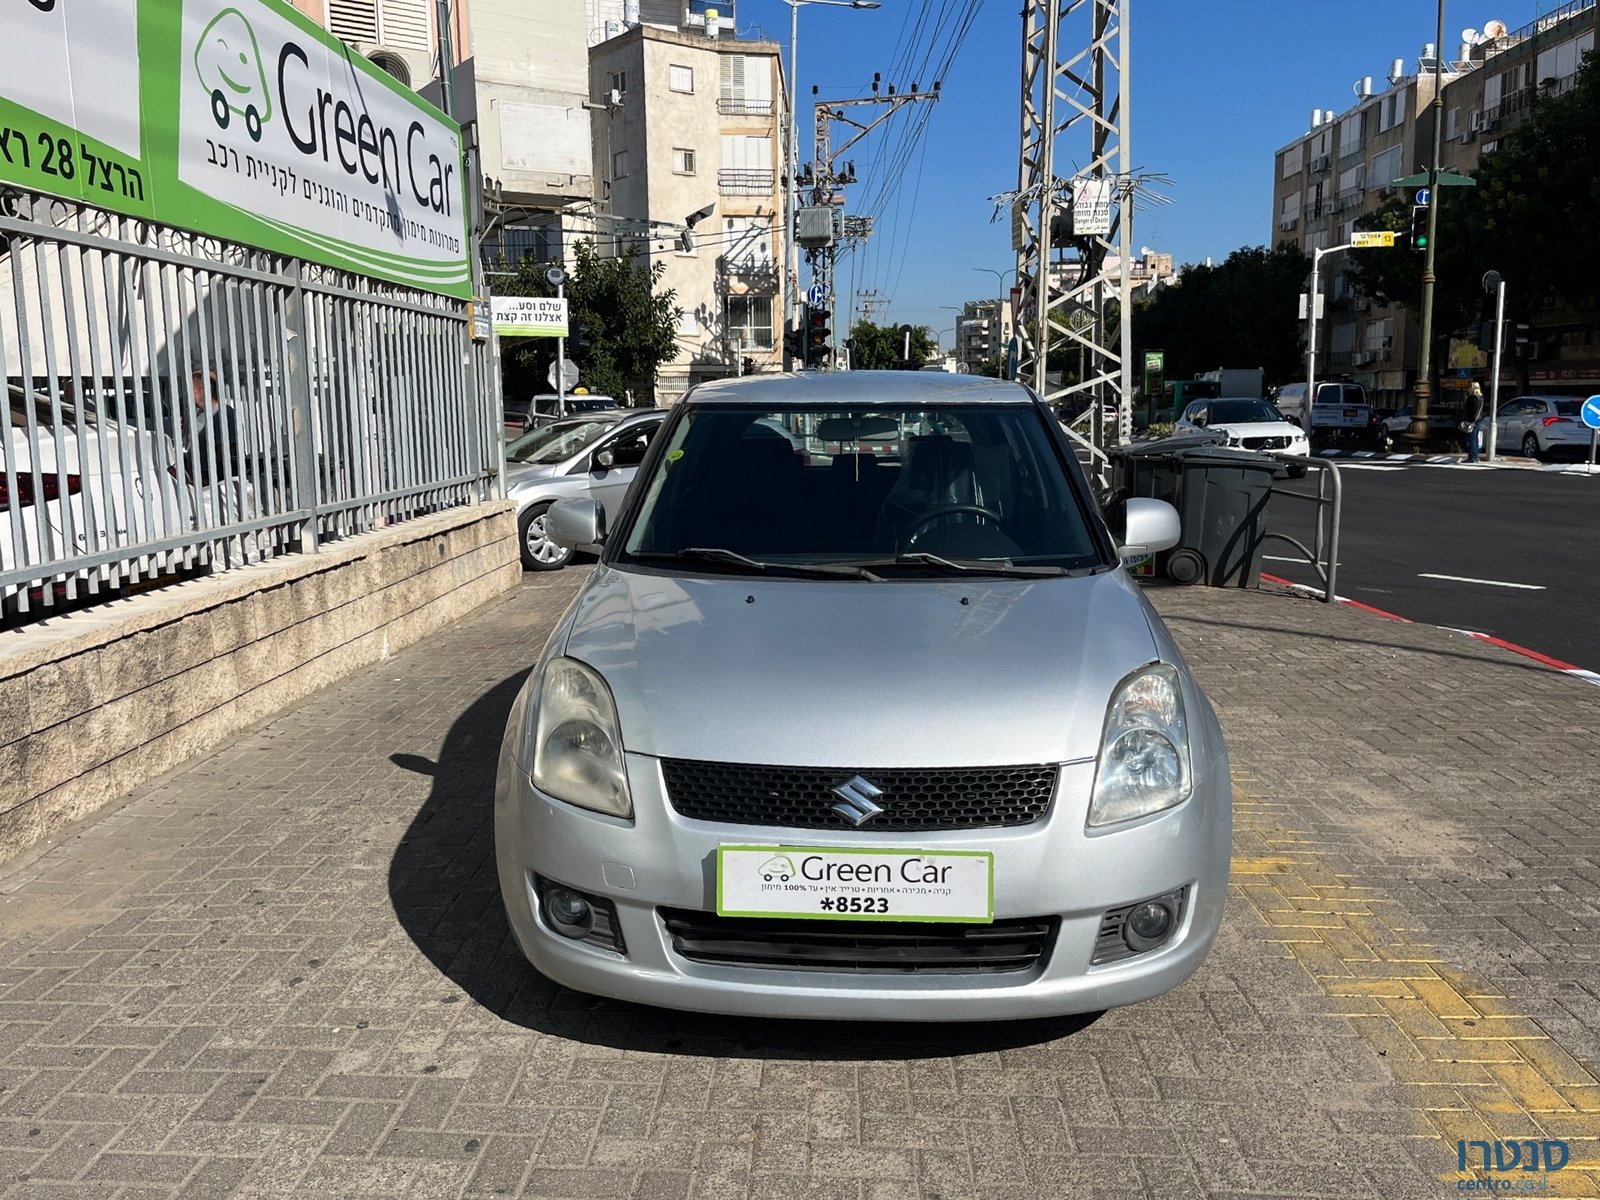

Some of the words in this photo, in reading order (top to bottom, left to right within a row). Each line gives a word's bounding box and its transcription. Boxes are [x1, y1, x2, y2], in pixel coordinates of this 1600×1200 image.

[278, 41, 402, 196] Green
[406, 119, 454, 217] Car
[38, 131, 75, 180] 28
[206, 138, 240, 173] רכב
[81, 142, 144, 201] הרצל
[246, 154, 297, 198] לקניית
[303, 178, 349, 214] והוגנים
[352, 198, 401, 232] מתקדמים
[402, 217, 427, 243] מימון
[428, 227, 460, 254] פתרונות
[509, 301, 536, 311] וסע...
[539, 301, 562, 311] שלם
[496, 312, 518, 323] קצת
[521, 313, 532, 322] זה
[535, 312, 562, 322] אצלנו
[801, 855, 892, 883] Green
[900, 858, 953, 885] Car
[761, 884, 782, 892] מימון
[784, 884, 807, 892] 100%
[824, 885, 837, 893] אין
[866, 886, 895, 894] אחריות
[902, 887, 927, 895] מכירה
[933, 887, 952, 896] קניה
